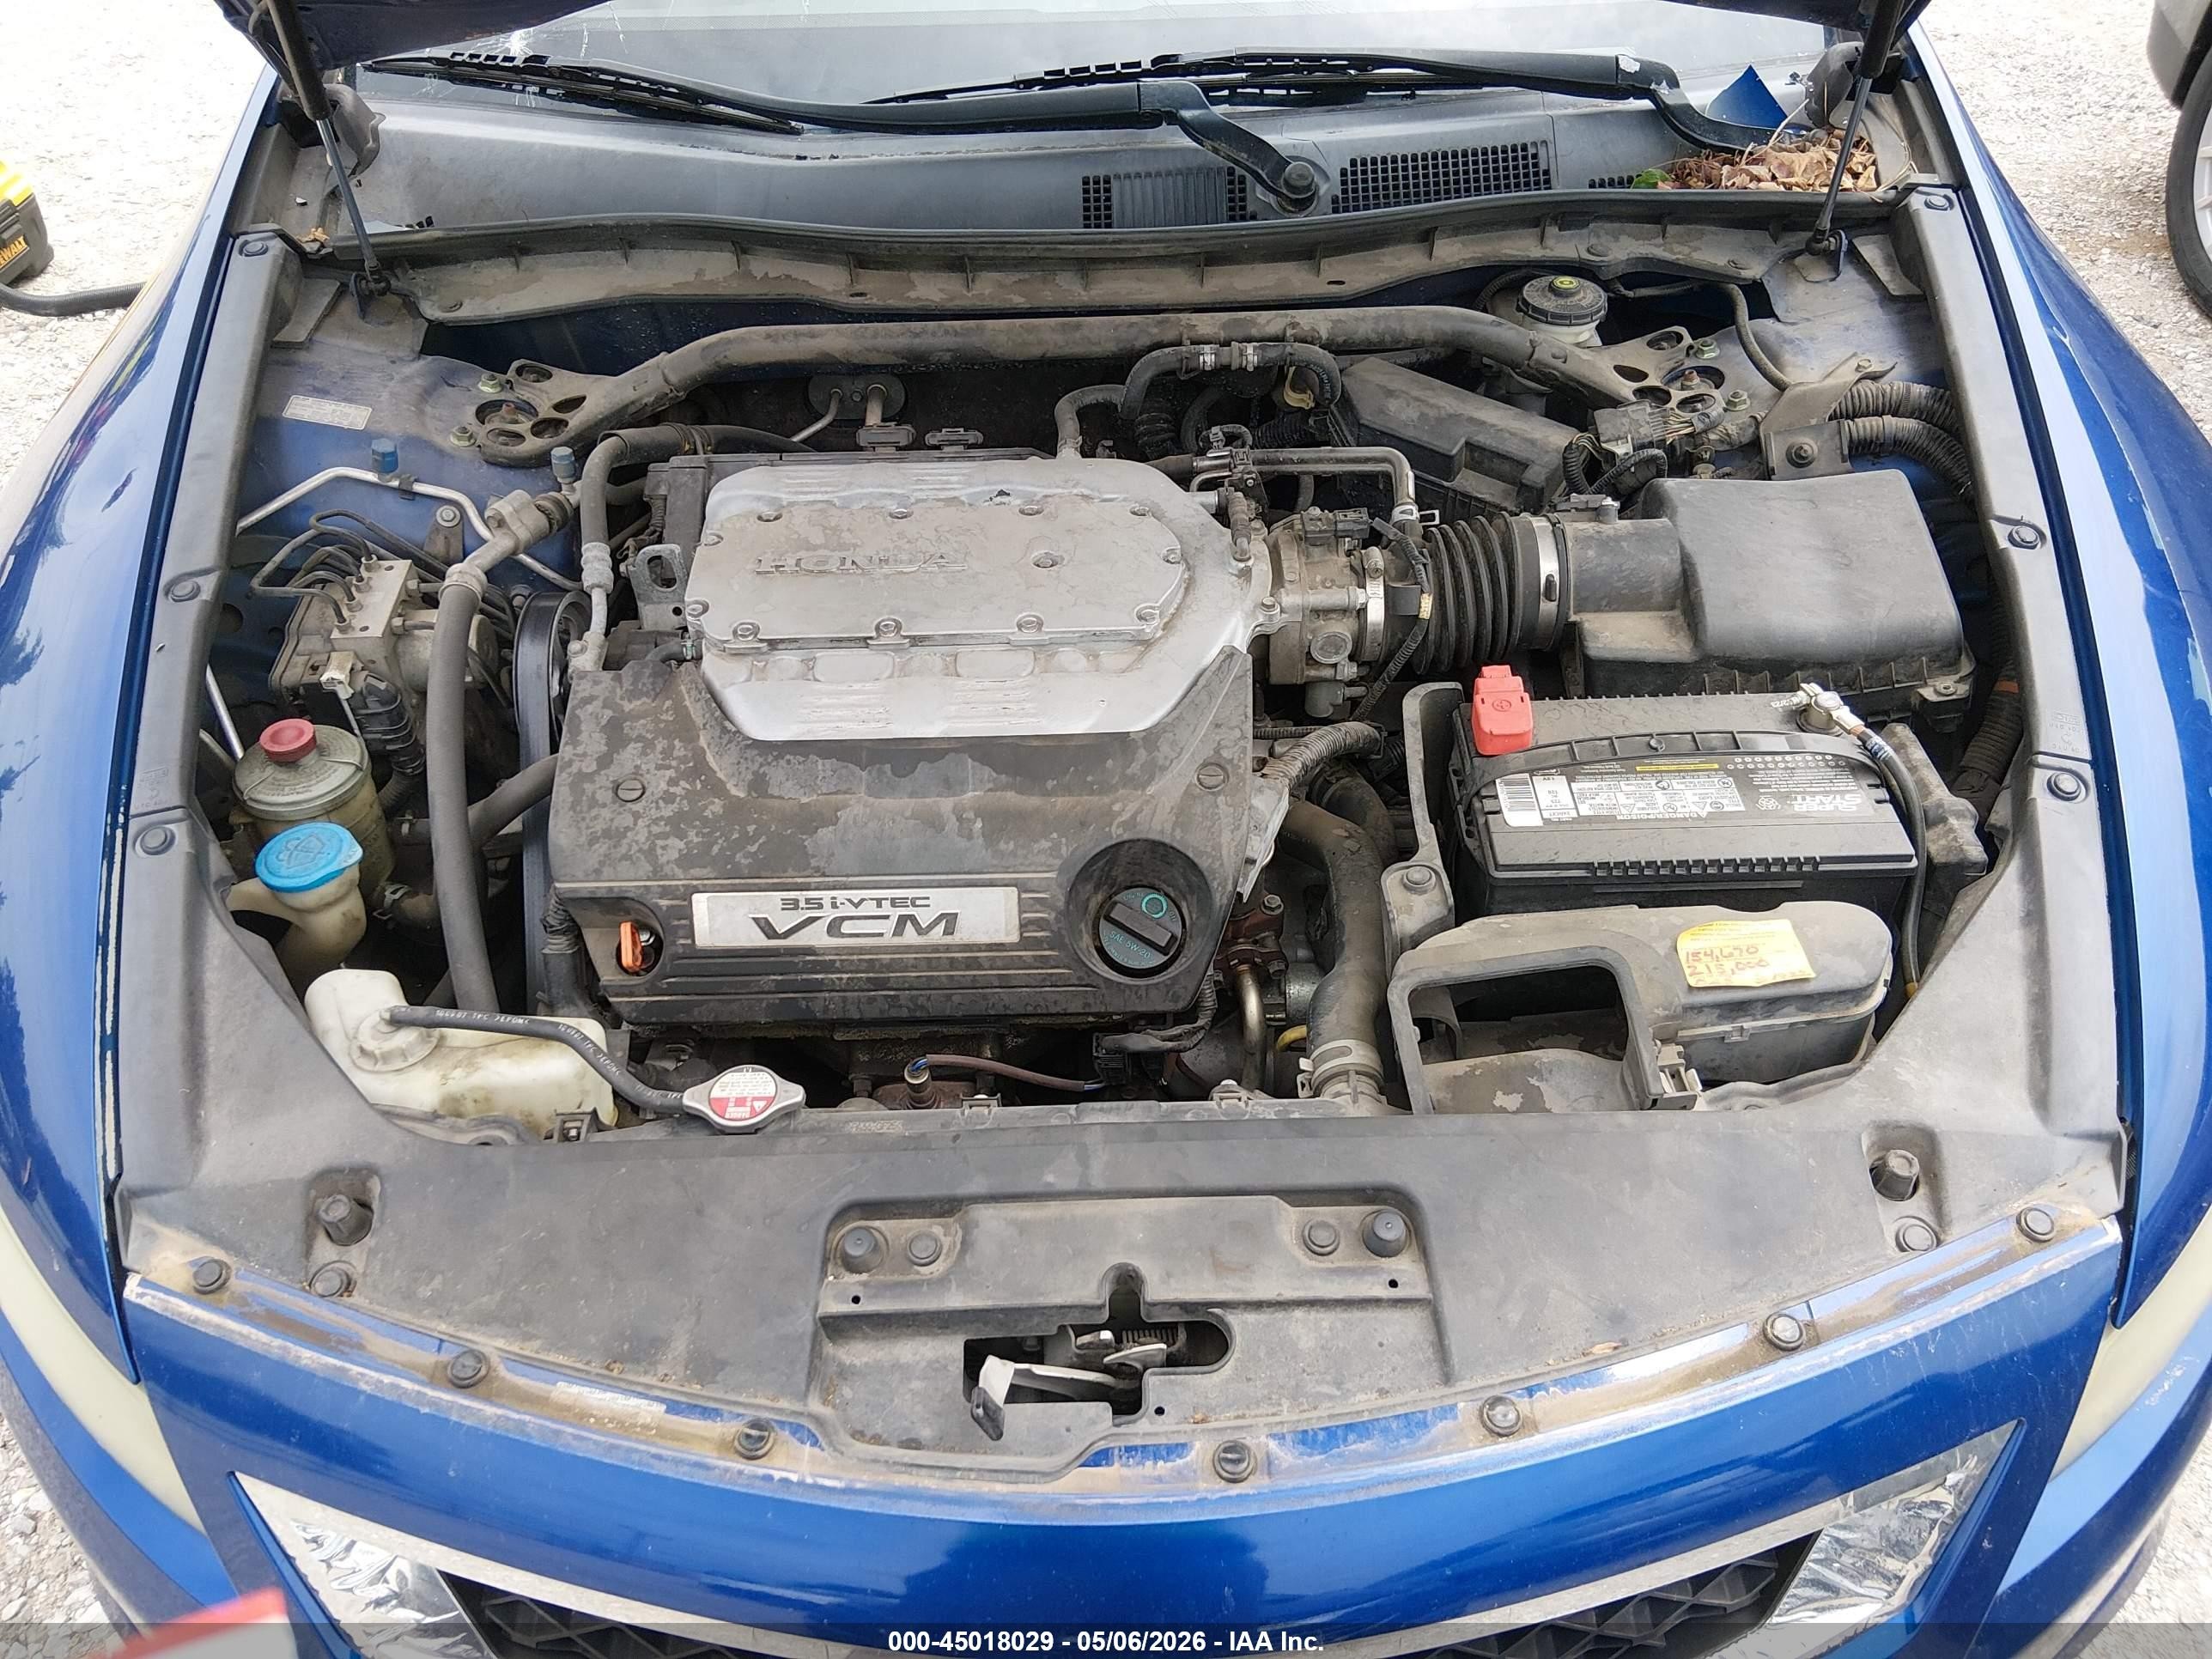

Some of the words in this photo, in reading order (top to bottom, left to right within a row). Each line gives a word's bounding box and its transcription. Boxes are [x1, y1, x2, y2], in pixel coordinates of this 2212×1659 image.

[755, 553, 968, 575] HONDA
[1793, 793, 1862, 805] START
[1793, 803, 1857, 812] SUPER
[781, 897, 823, 911] 3.5
[830, 896, 931, 909] i-VTEC
[748, 910, 963, 941] VCM
[1109, 931, 1125, 944] SAE
[1126, 940, 1151, 958] 5W-20
